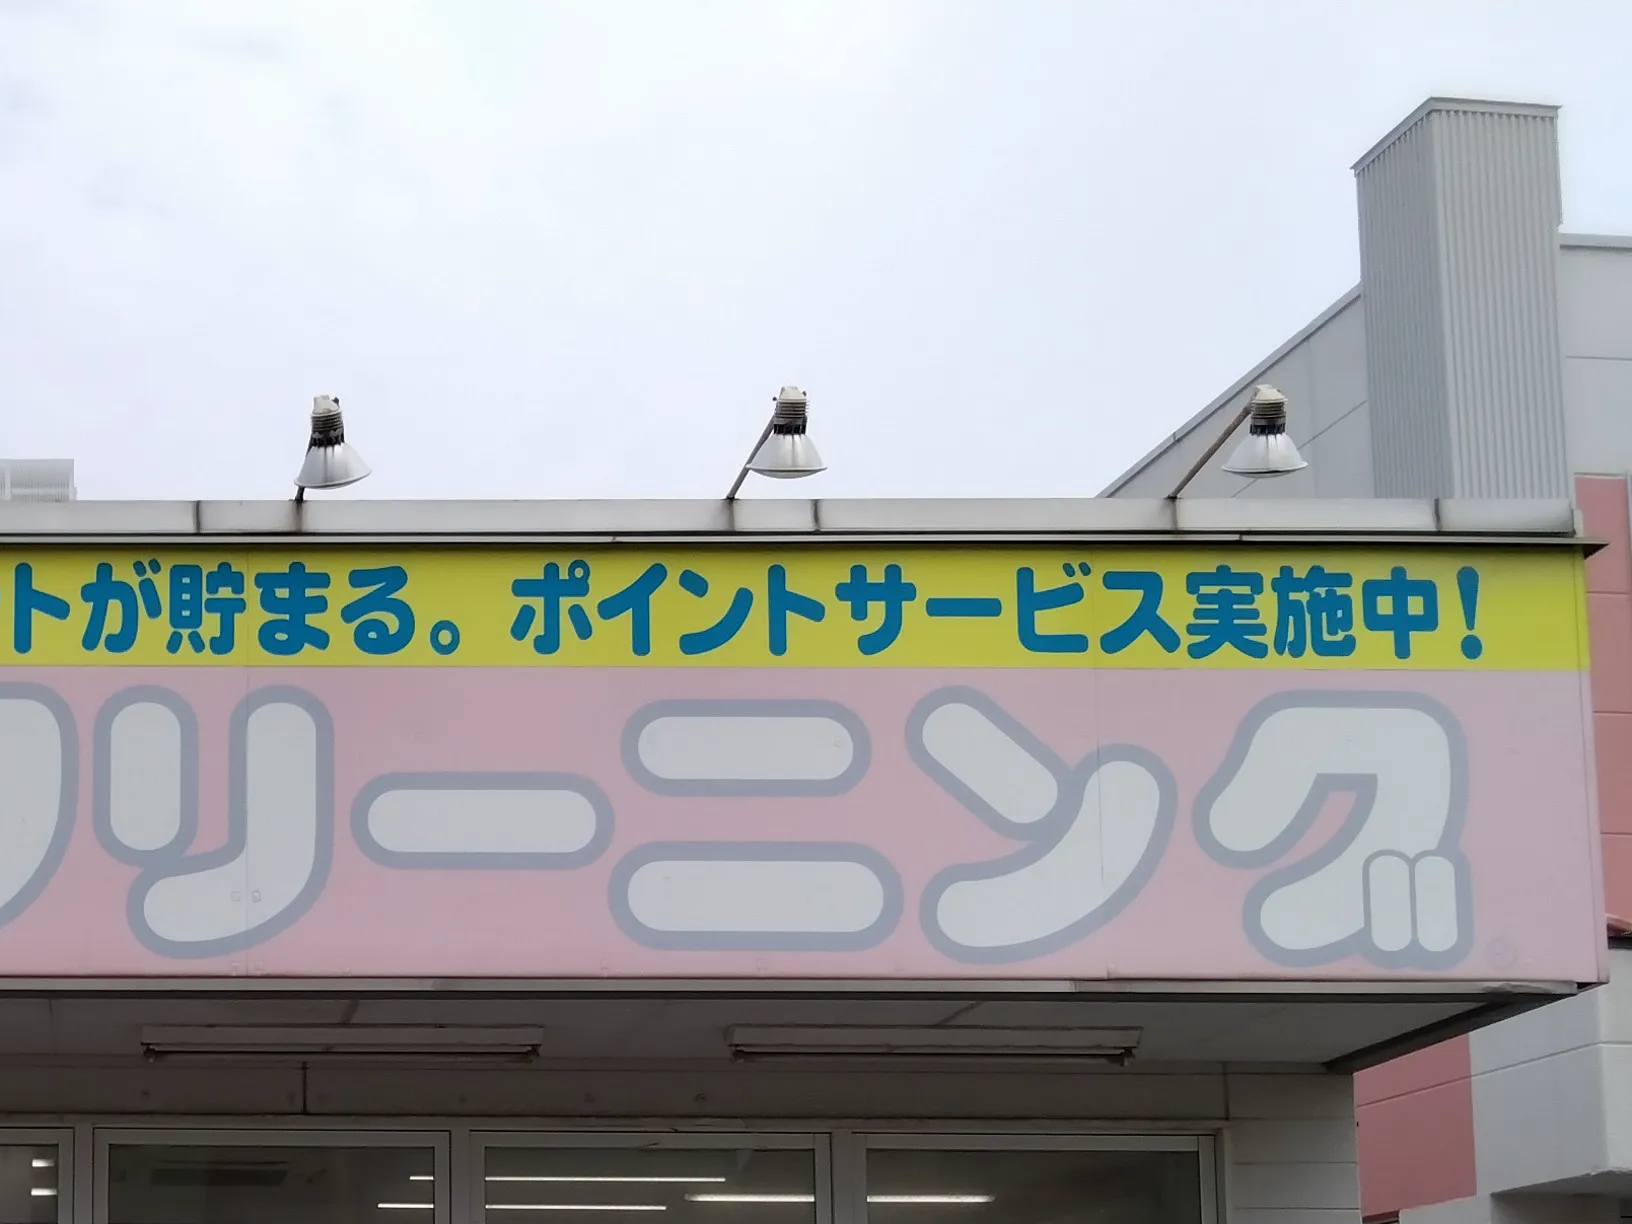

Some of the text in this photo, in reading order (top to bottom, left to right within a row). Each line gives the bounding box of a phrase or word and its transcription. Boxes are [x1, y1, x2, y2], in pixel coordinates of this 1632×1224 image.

[510, 560, 1486, 660] ポイントサービス実施中!
